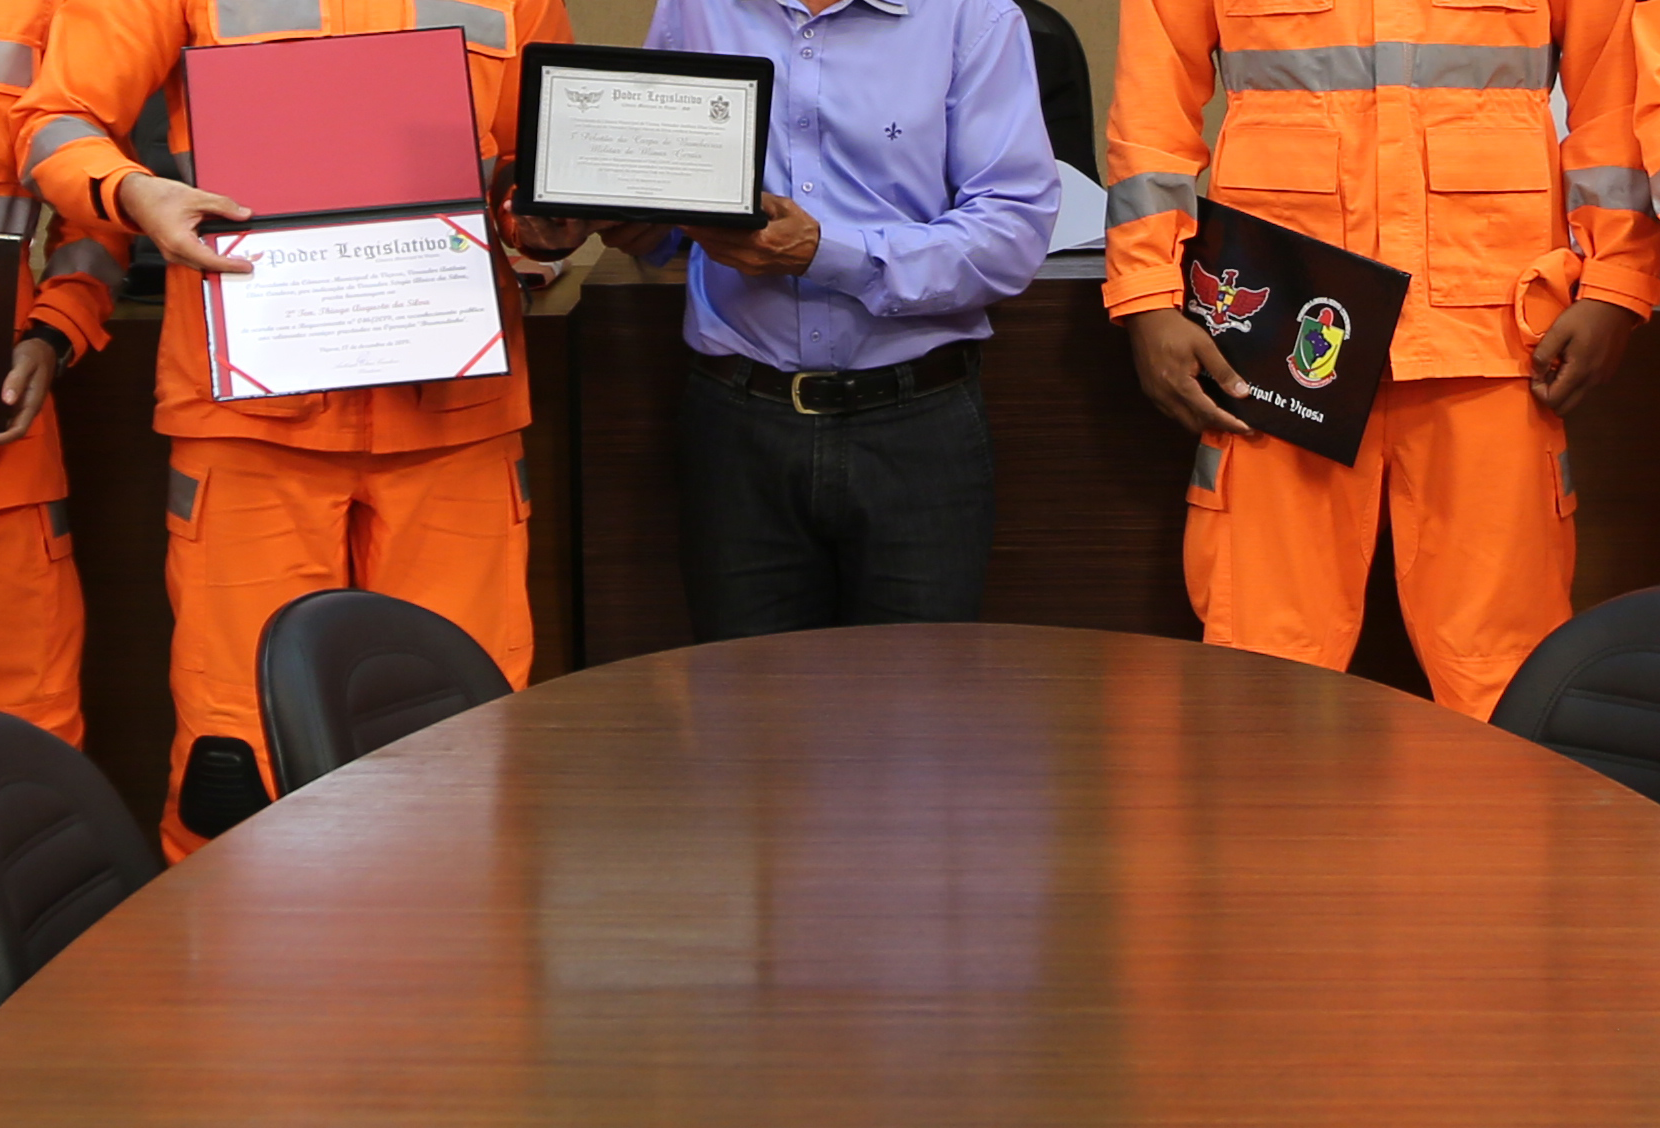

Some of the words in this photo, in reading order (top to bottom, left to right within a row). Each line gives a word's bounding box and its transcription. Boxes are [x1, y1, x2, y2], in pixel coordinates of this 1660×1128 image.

[612, 88, 642, 102] Poder
[646, 90, 703, 106] Legislativo
[262, 248, 328, 267] Poder
[335, 236, 447, 261] Legislativo
[1274, 393, 1288, 408] de
[1290, 397, 1324, 423] Viçosa
